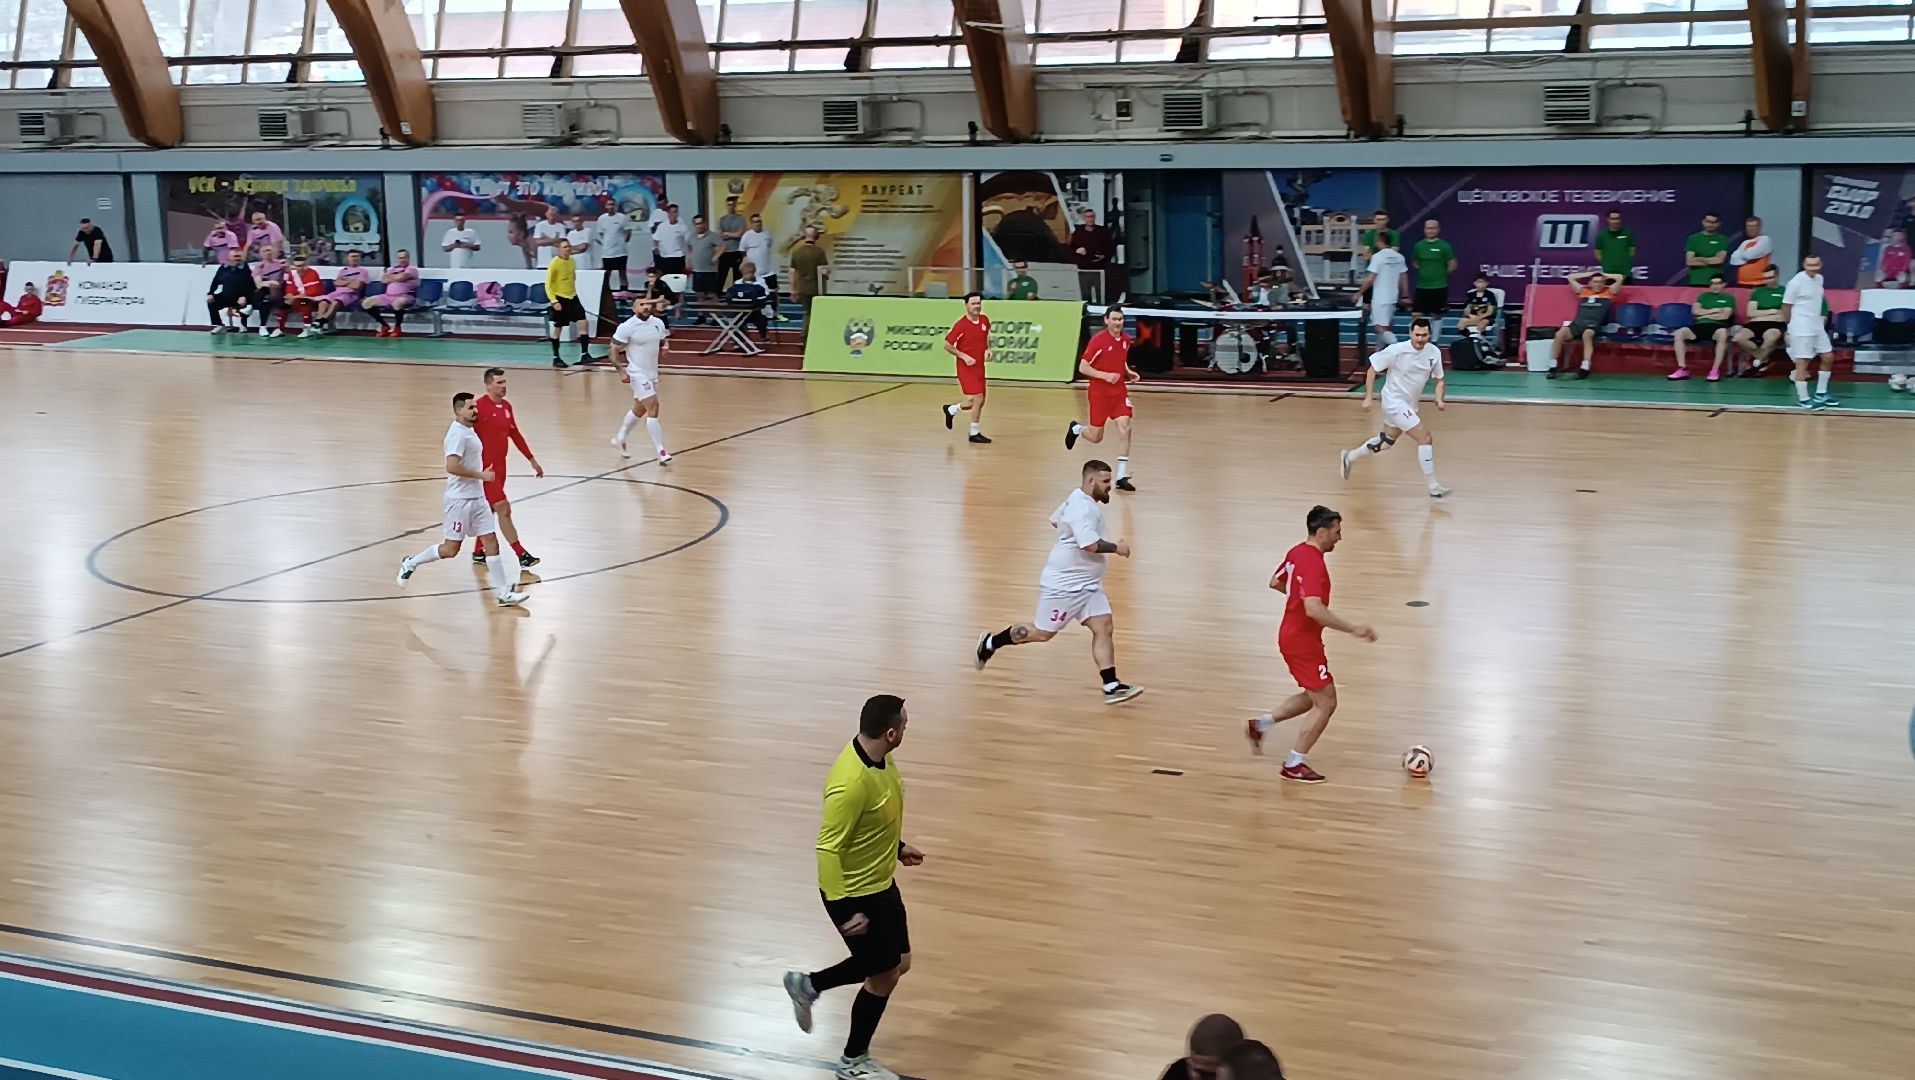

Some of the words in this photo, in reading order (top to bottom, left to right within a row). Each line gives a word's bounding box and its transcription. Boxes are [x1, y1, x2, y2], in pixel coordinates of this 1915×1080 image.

[861, 184, 923, 196] ЛАУРЕАТ
[1457, 188, 1559, 203] ЩЁЛКОВСКОЕ
[1564, 189, 1676, 203] ТЕЛЕВИДЕНИЕ
[883, 340, 934, 352] РОССИИ
[452, 521, 463, 534] 13
[1050, 609, 1069, 622] 34
